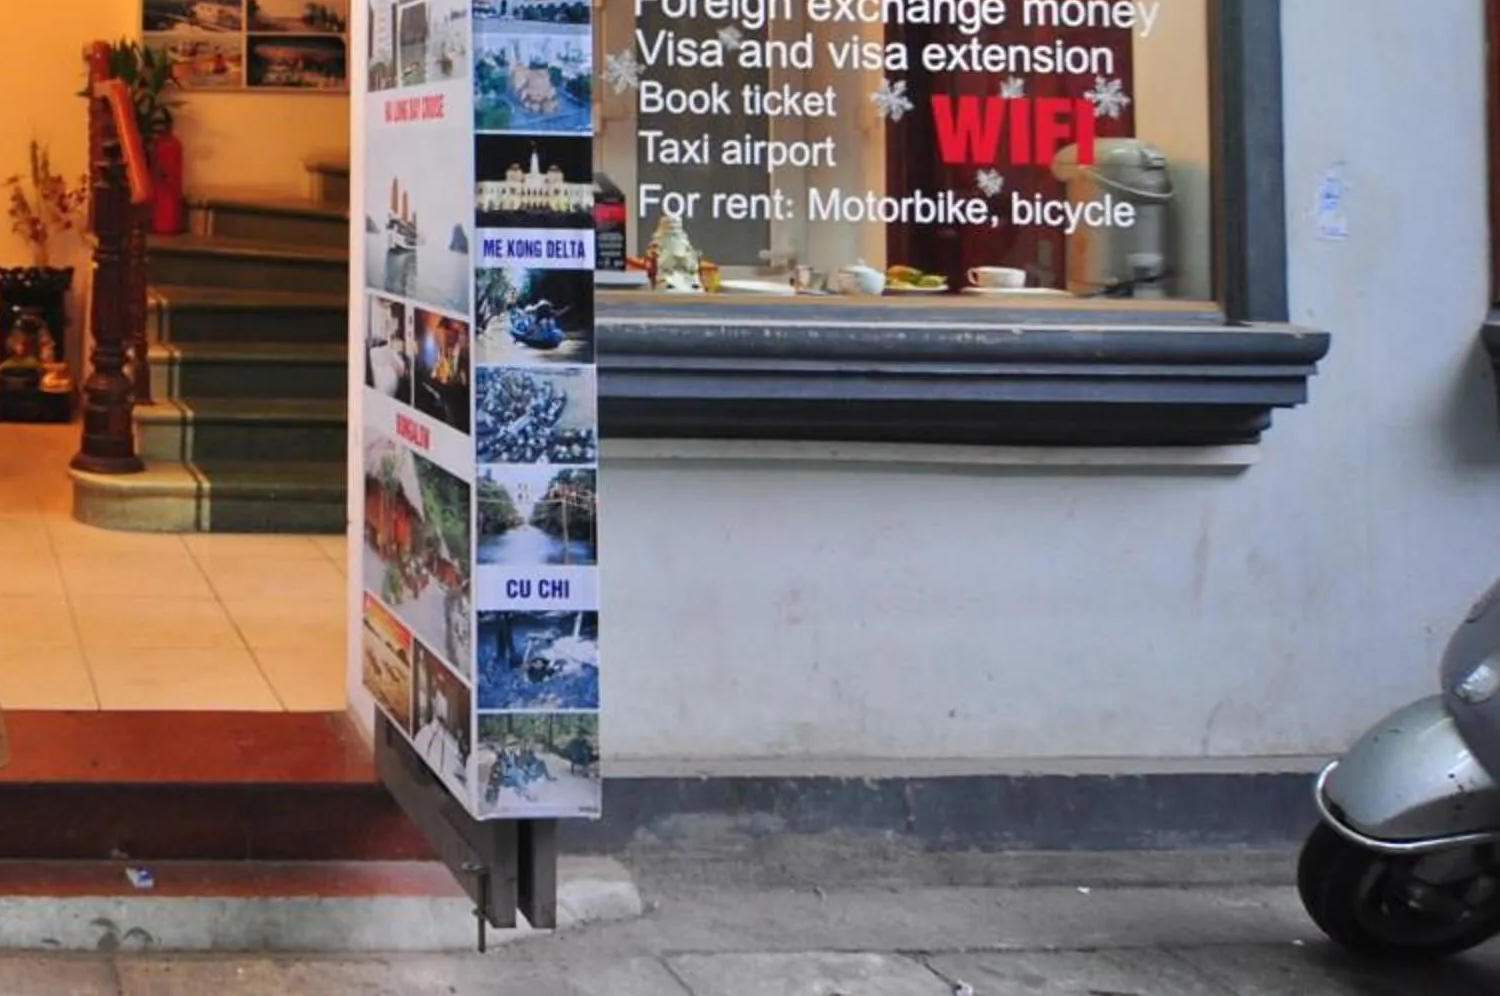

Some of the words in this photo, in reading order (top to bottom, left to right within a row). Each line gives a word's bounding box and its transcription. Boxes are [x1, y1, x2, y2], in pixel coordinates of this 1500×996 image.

[635, 29, 724, 68] Visa
[739, 32, 813, 70] and
[829, 36, 908, 71] visa
[922, 39, 1114, 75] extension
[640, 82, 731, 115] Book
[743, 83, 837, 118] ticket
[932, 93, 1095, 165] WIFI
[639, 131, 710, 165] Taxi
[722, 134, 837, 175] airport
[639, 184, 700, 219] For
[713, 188, 793, 221] rent:
[808, 188, 999, 227] Motorbike,
[1012, 191, 1136, 233] bicycle
[483, 240, 503, 259] ME
[507, 240, 542, 259] KONG
[546, 240, 586, 260] DELTA
[506, 579, 531, 599] CU
[538, 579, 570, 599] CHI
